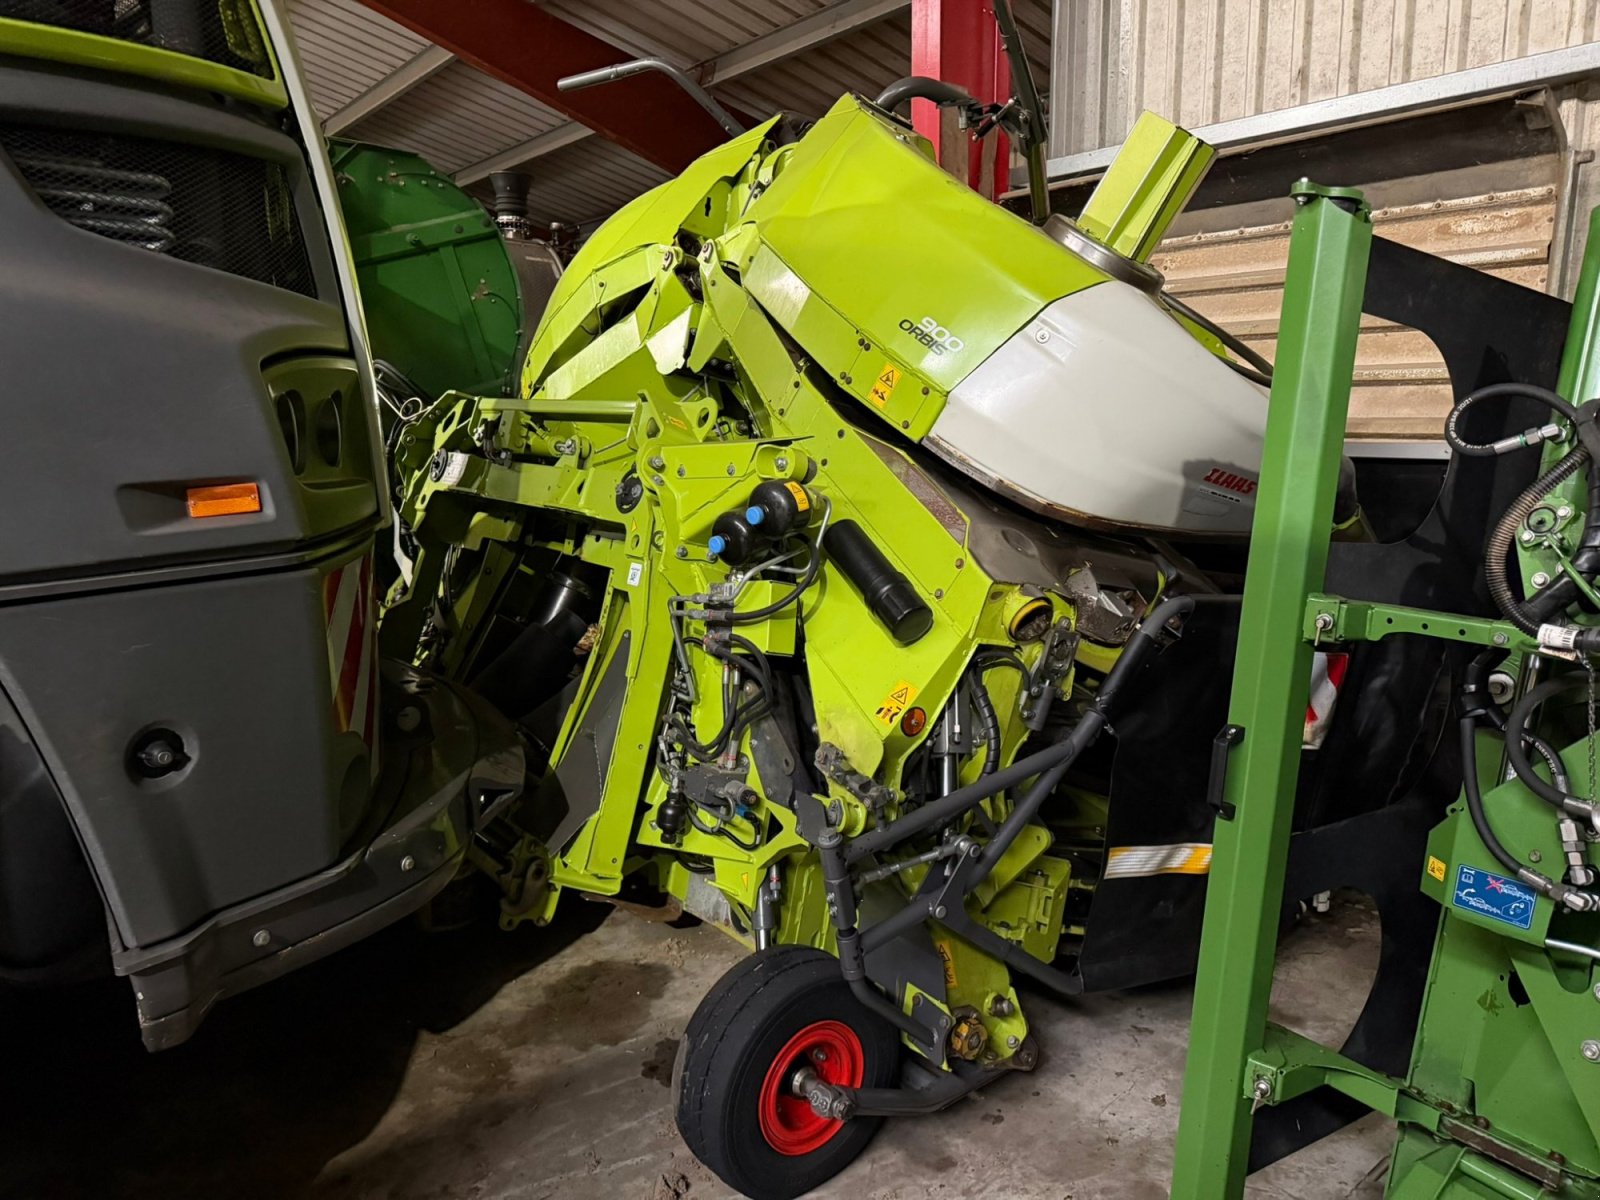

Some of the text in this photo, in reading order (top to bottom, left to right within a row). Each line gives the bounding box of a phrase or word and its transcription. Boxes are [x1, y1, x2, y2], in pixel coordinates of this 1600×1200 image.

[899, 319, 948, 356] ORBIS
[917, 316, 964, 352] 900
[1203, 467, 1257, 495] CLAAS
